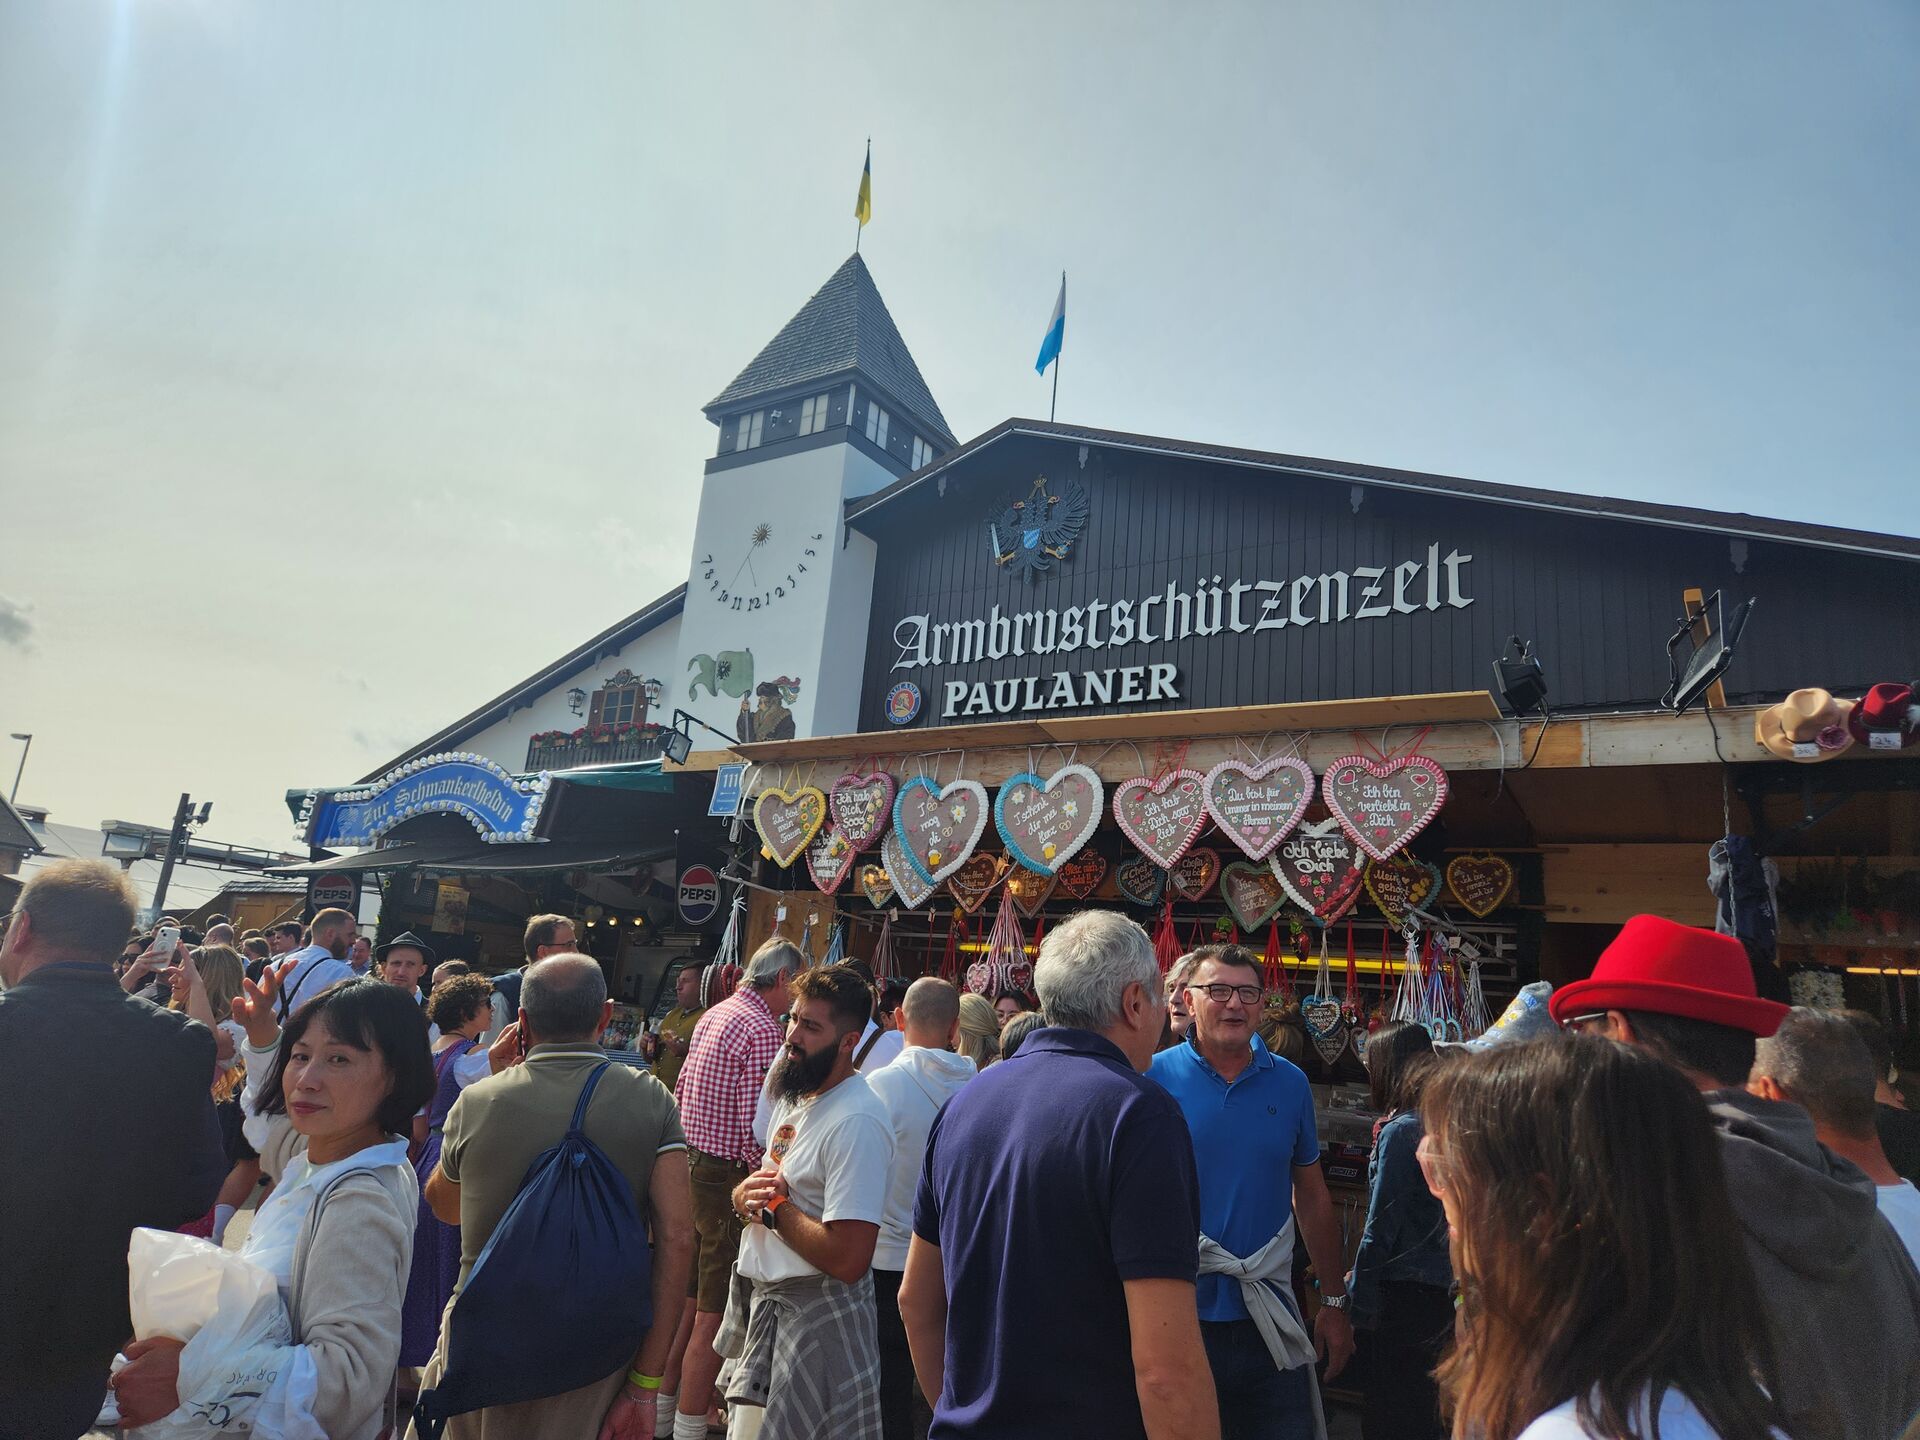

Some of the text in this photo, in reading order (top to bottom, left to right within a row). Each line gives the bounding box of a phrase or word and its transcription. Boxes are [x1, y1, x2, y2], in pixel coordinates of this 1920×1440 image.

[700, 533, 822, 612] 7 8 9 10 11 12 1 2 3 4 5 6
[890, 541, 1475, 673] Armbrustschützenzelt
[941, 663, 1180, 719] PAULANER
[723, 772, 740, 788] 111
[836, 789, 870, 805] Ich hab
[1228, 786, 1280, 802] Du bist für
[1362, 783, 1402, 798] Ich bin
[362, 776, 514, 830] Zur Schmankerlheldin
[840, 802, 864, 818] Dich
[1021, 797, 1049, 822] schenk
[1144, 794, 1181, 817] Ich hab
[1224, 804, 1250, 815] immer
[1251, 801, 1260, 811] in
[1357, 799, 1412, 812] verliebt in
[772, 806, 800, 825] Du bist
[1028, 806, 1058, 836] dir mei
[1148, 813, 1170, 830] Dich
[1242, 814, 1272, 826] Herzen
[1369, 812, 1396, 827] Dich
[777, 820, 795, 833] mein
[920, 816, 941, 832] mog
[1157, 823, 1177, 839] lieb
[780, 828, 802, 844] Traum
[929, 831, 942, 847] di
[1038, 825, 1058, 844] Herz
[1282, 840, 1311, 859] Ich
[1129, 861, 1149, 878] Chef
[1182, 857, 1204, 868] Chefin
[1293, 858, 1335, 873] Dich
[1181, 869, 1192, 877] Du
[1373, 869, 1396, 881] Mein
[1235, 878, 1252, 891] Für
[314, 889, 352, 900] PEPSI
[680, 887, 716, 901] PEPSI
